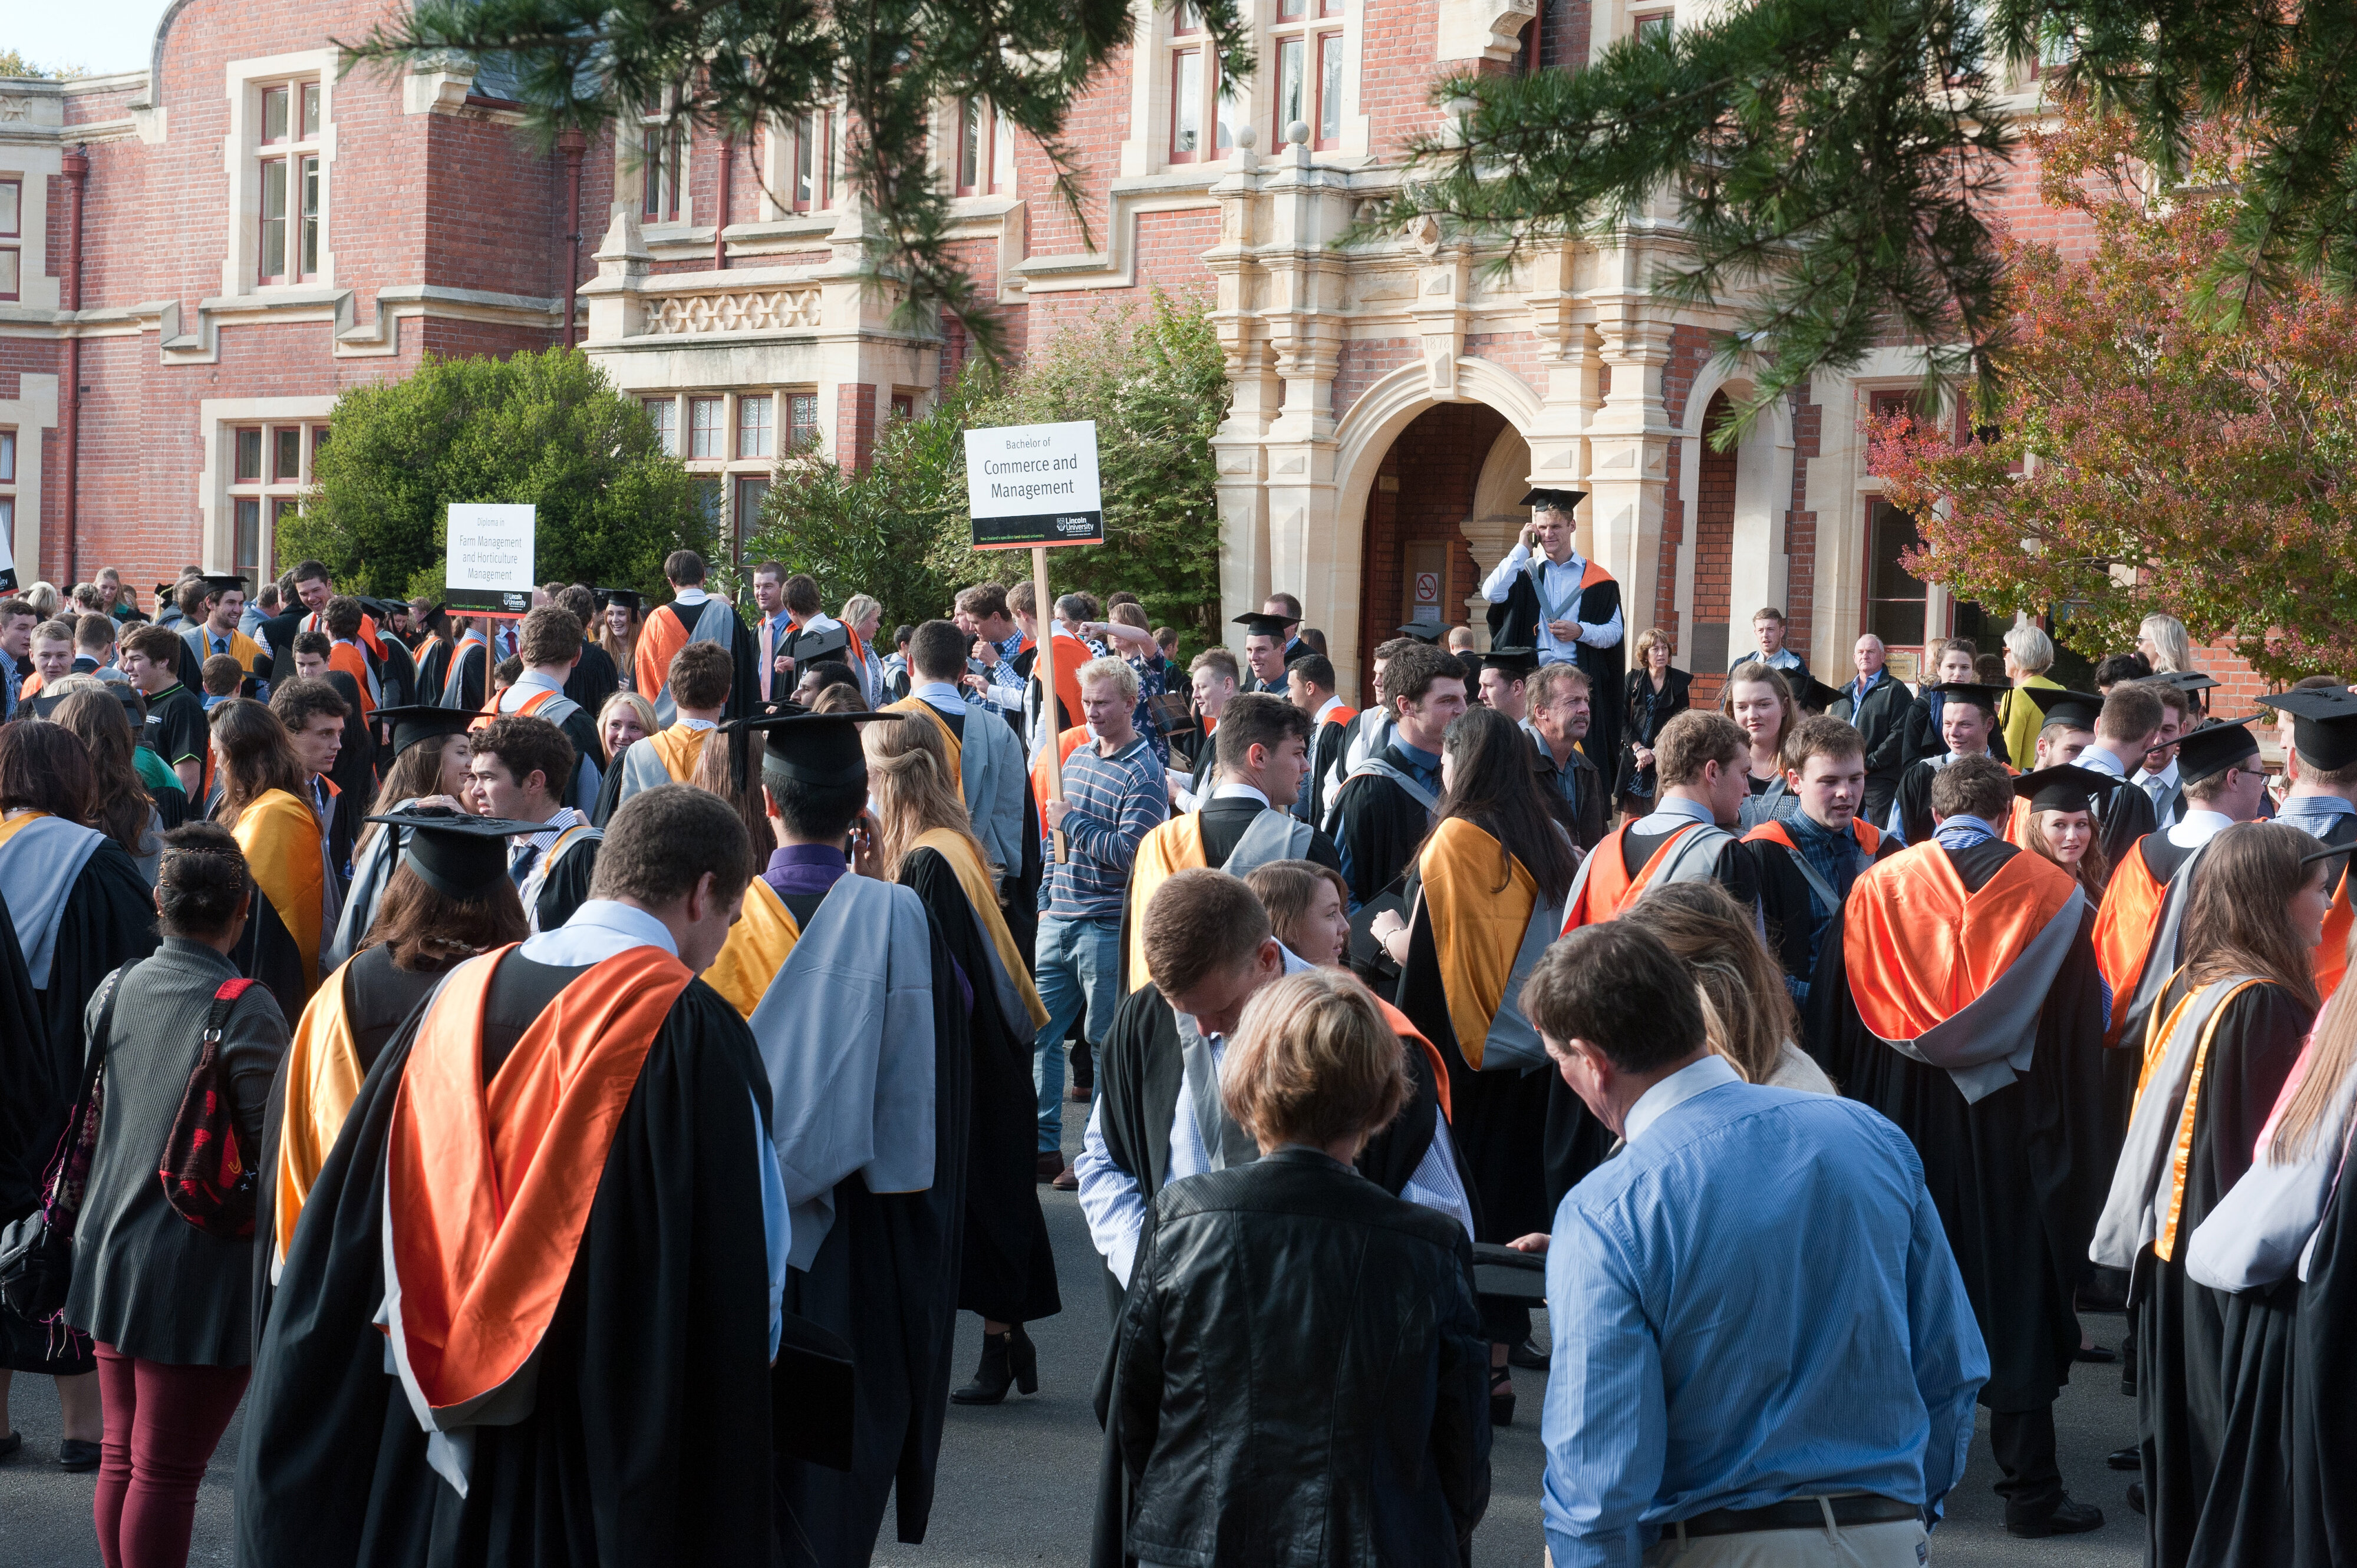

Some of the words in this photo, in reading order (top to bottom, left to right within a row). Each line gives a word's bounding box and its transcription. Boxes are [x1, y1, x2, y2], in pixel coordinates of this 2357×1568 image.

[1426, 336, 1450, 349] 1878
[1006, 438, 1041, 449] Bachelor
[1043, 437, 1051, 447] of
[984, 459, 1049, 475] Commerce
[1053, 453, 1077, 470] and
[991, 480, 1074, 500] Management
[477, 517, 499, 527] Diploma
[500, 518, 505, 527] in
[1065, 516, 1087, 524] Lincoln
[1066, 523, 1094, 531] University
[460, 535, 476, 546] Farm
[477, 536, 522, 550] Management
[463, 552, 475, 563] and
[477, 552, 518, 564] Horticulture
[468, 568, 512, 582] Management
[509, 599, 526, 608] University
